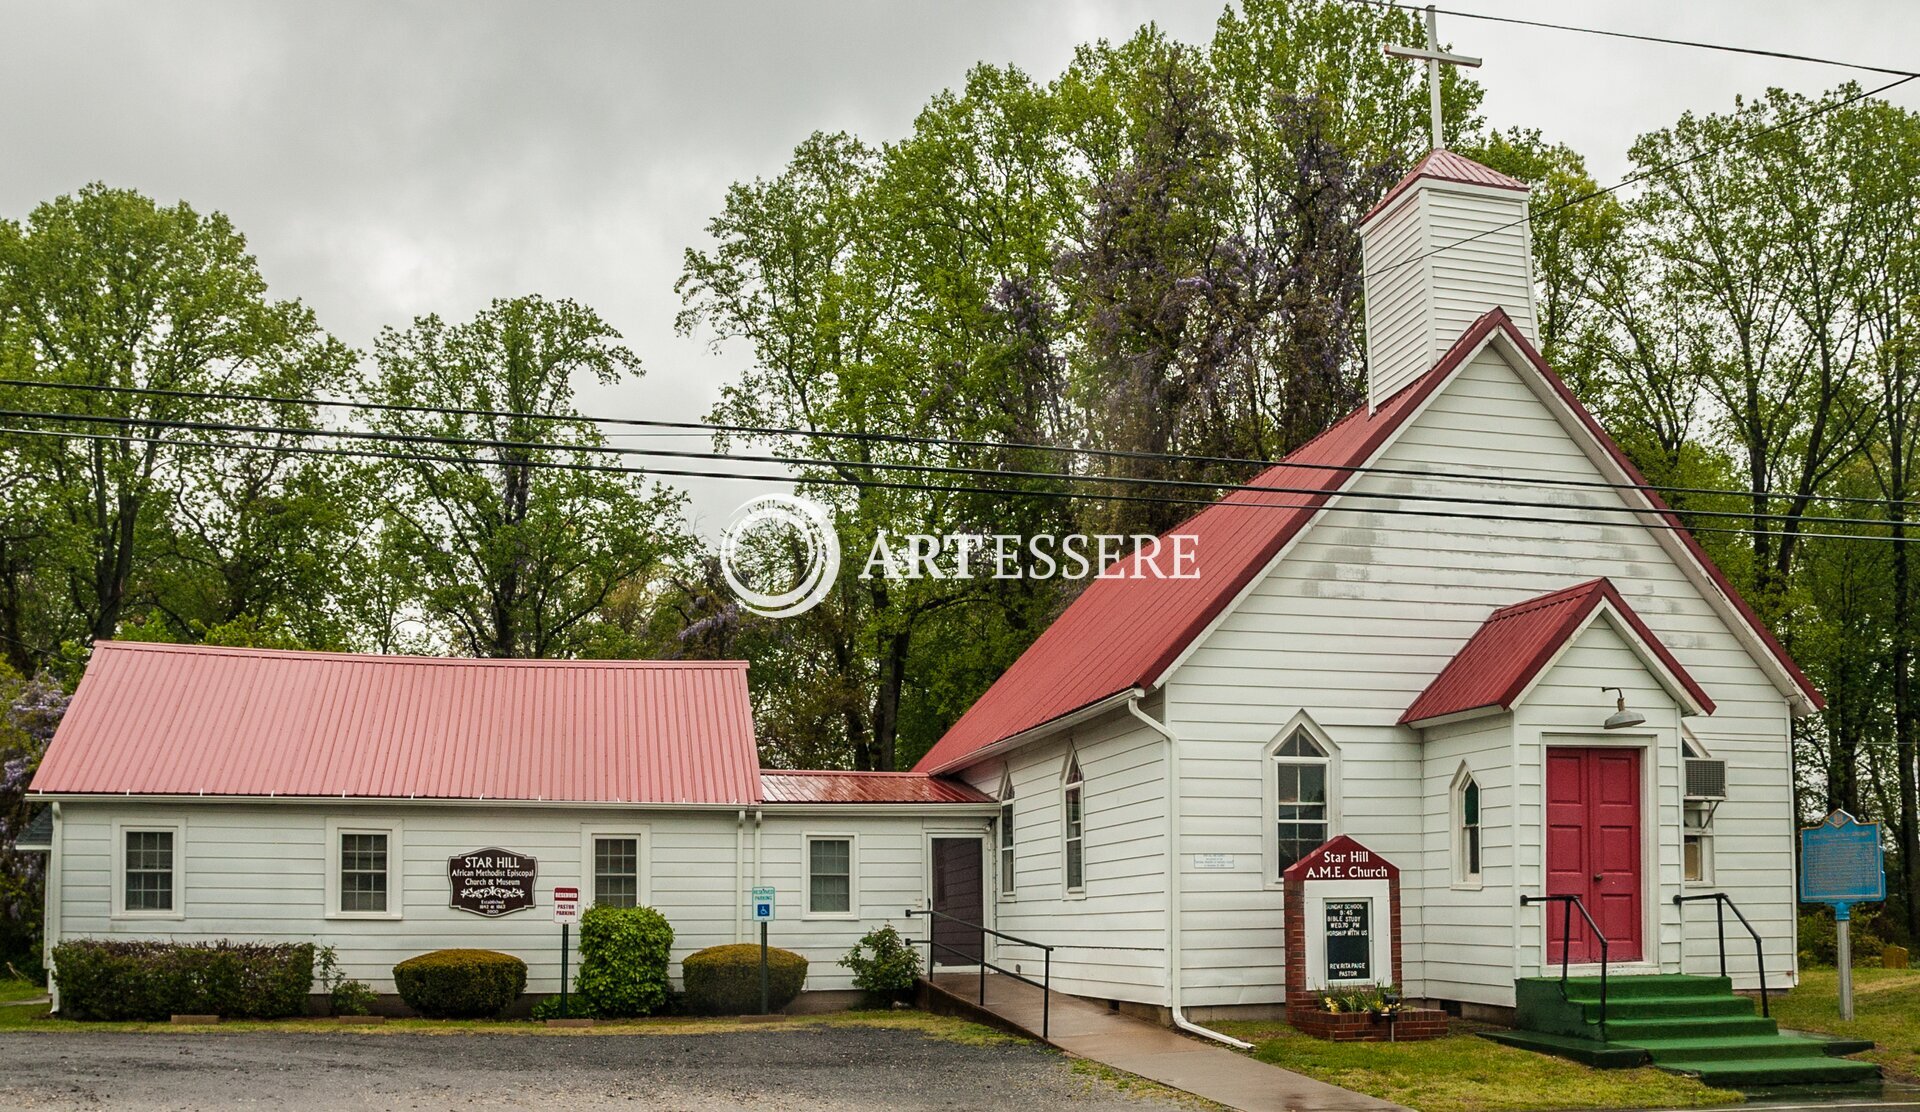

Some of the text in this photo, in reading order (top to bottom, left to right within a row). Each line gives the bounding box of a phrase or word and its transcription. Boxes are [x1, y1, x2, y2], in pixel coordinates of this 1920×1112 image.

[465, 857, 520, 868] STAR HILL
[1324, 851, 1369, 863] Star Hill
[452, 869, 534, 878] African Methodist Episcopal
[1306, 866, 1388, 878] A.M.E. Church
[465, 878, 520, 886] Church & Museum
